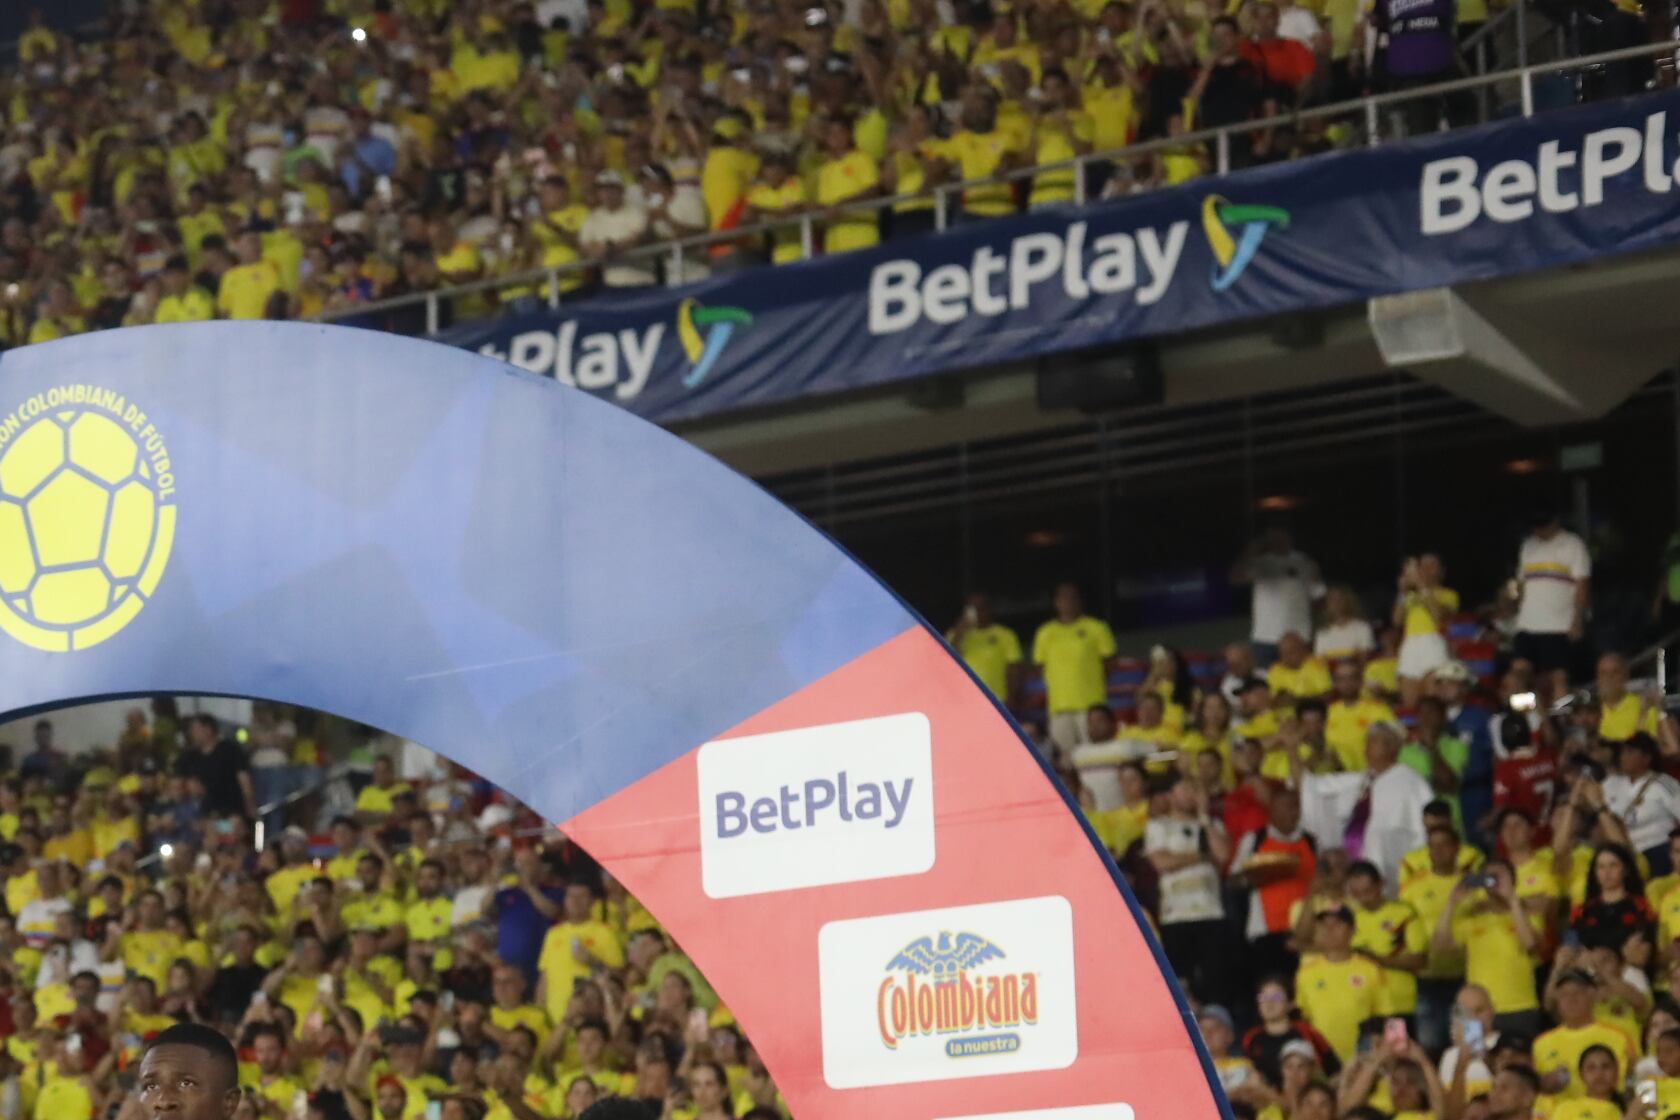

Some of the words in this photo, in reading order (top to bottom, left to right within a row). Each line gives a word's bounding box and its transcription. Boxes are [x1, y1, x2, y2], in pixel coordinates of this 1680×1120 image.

[1420, 110, 1680, 235] BetPl
[869, 220, 1190, 335] BetPlay
[18, 384, 126, 421] COLOMBIANA
[123, 403, 147, 431] DE
[139, 424, 176, 500] FÚTBOL
[715, 770, 914, 839] BetPlay
[877, 970, 1038, 1050] Colombiana
[949, 1041, 962, 1055] la
[963, 1037, 1017, 1054] nuestra
